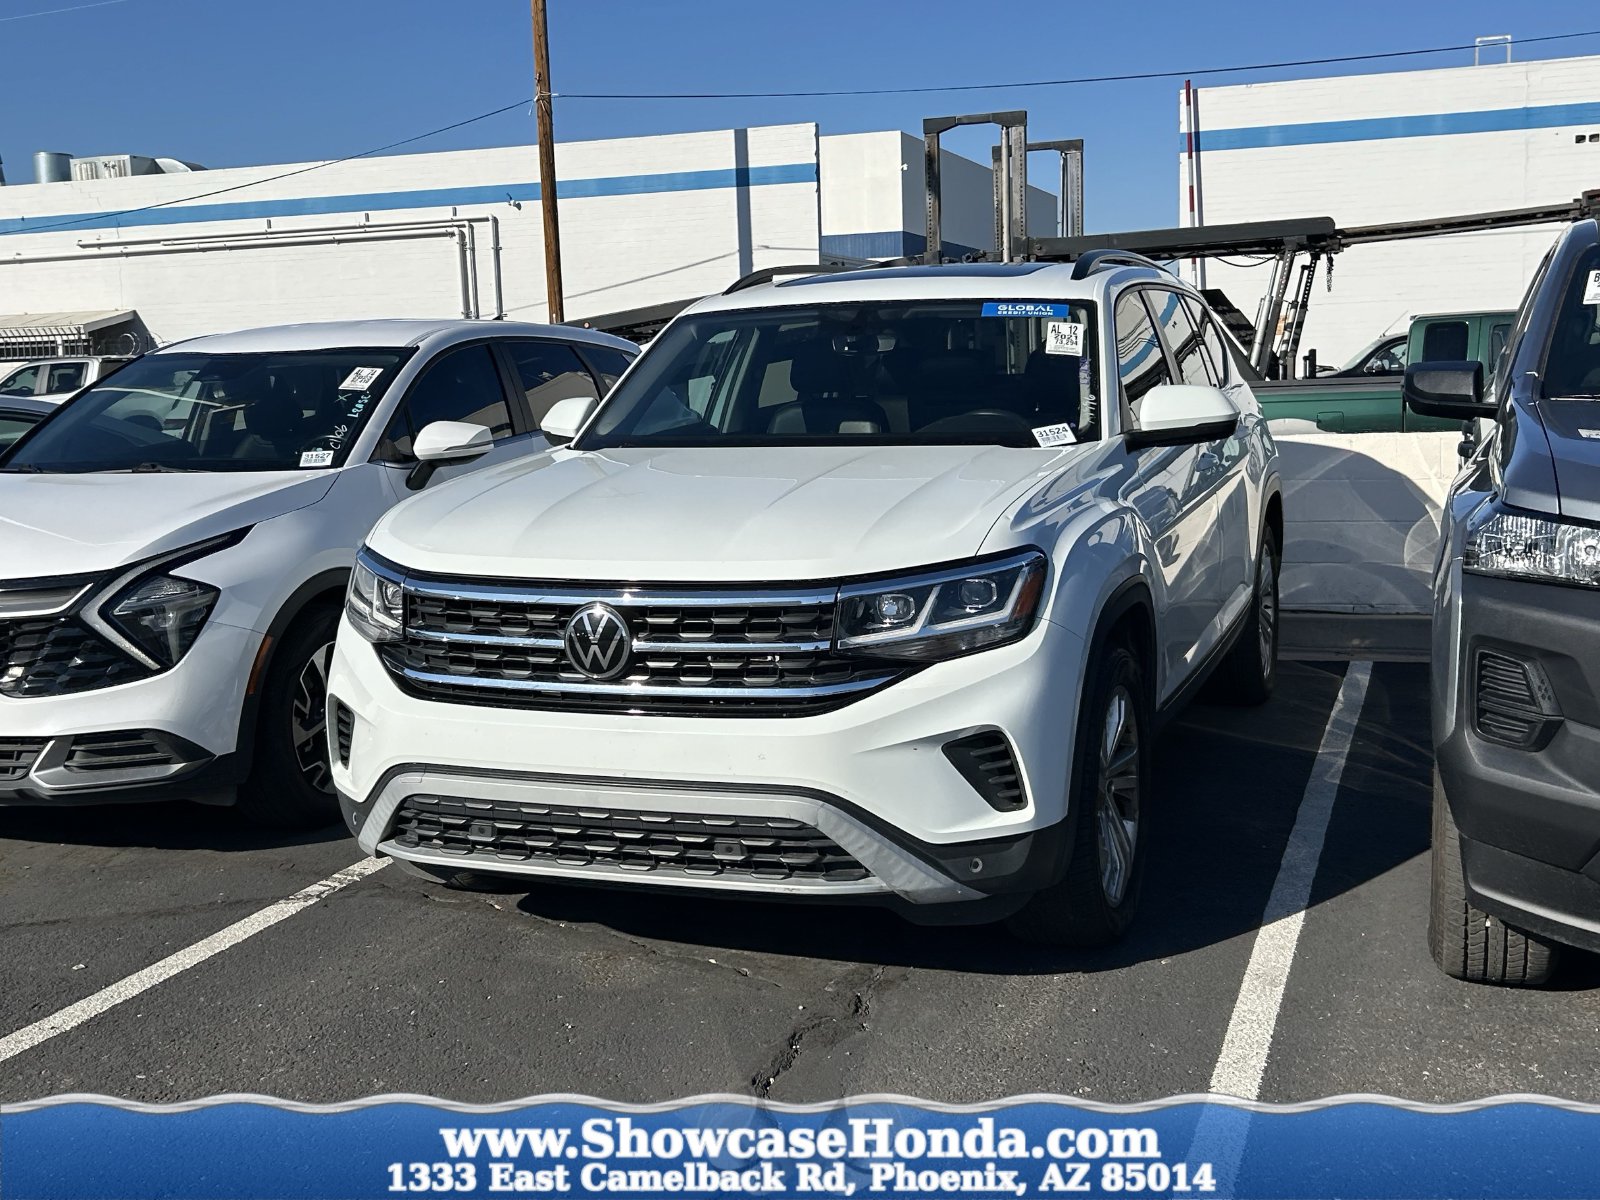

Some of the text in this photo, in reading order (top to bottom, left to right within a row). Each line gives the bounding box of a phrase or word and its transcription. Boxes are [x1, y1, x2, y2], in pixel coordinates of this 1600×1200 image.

[997, 304, 1054, 312] GLOBAL
[1050, 324, 1078, 335] AL 12
[1036, 426, 1068, 438] 31524
